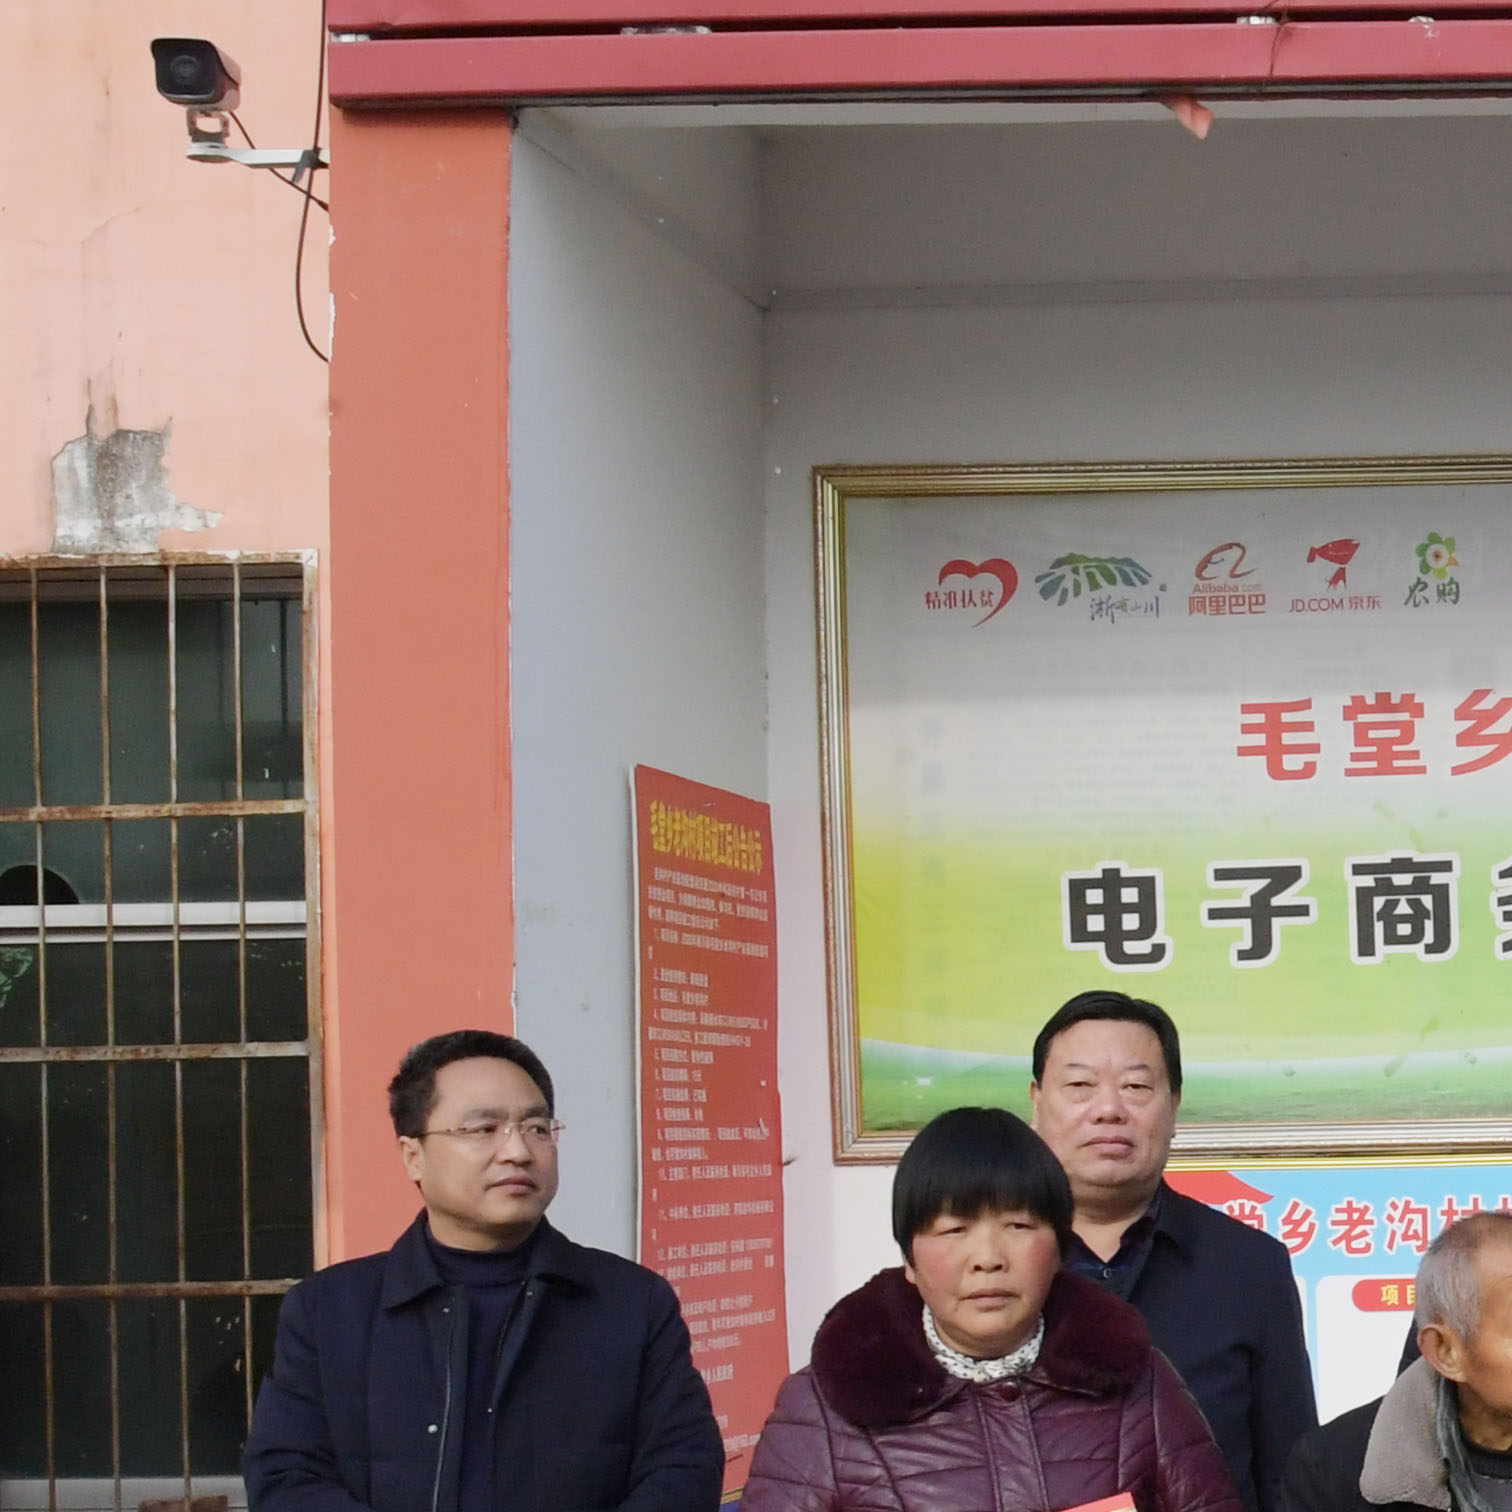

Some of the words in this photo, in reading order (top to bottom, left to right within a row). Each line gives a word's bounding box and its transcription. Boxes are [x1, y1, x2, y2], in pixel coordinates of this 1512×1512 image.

[1188, 593, 1267, 616] 阿里巴巴
[1289, 597, 1344, 614] JD.COM
[1348, 595, 1382, 611] 京东
